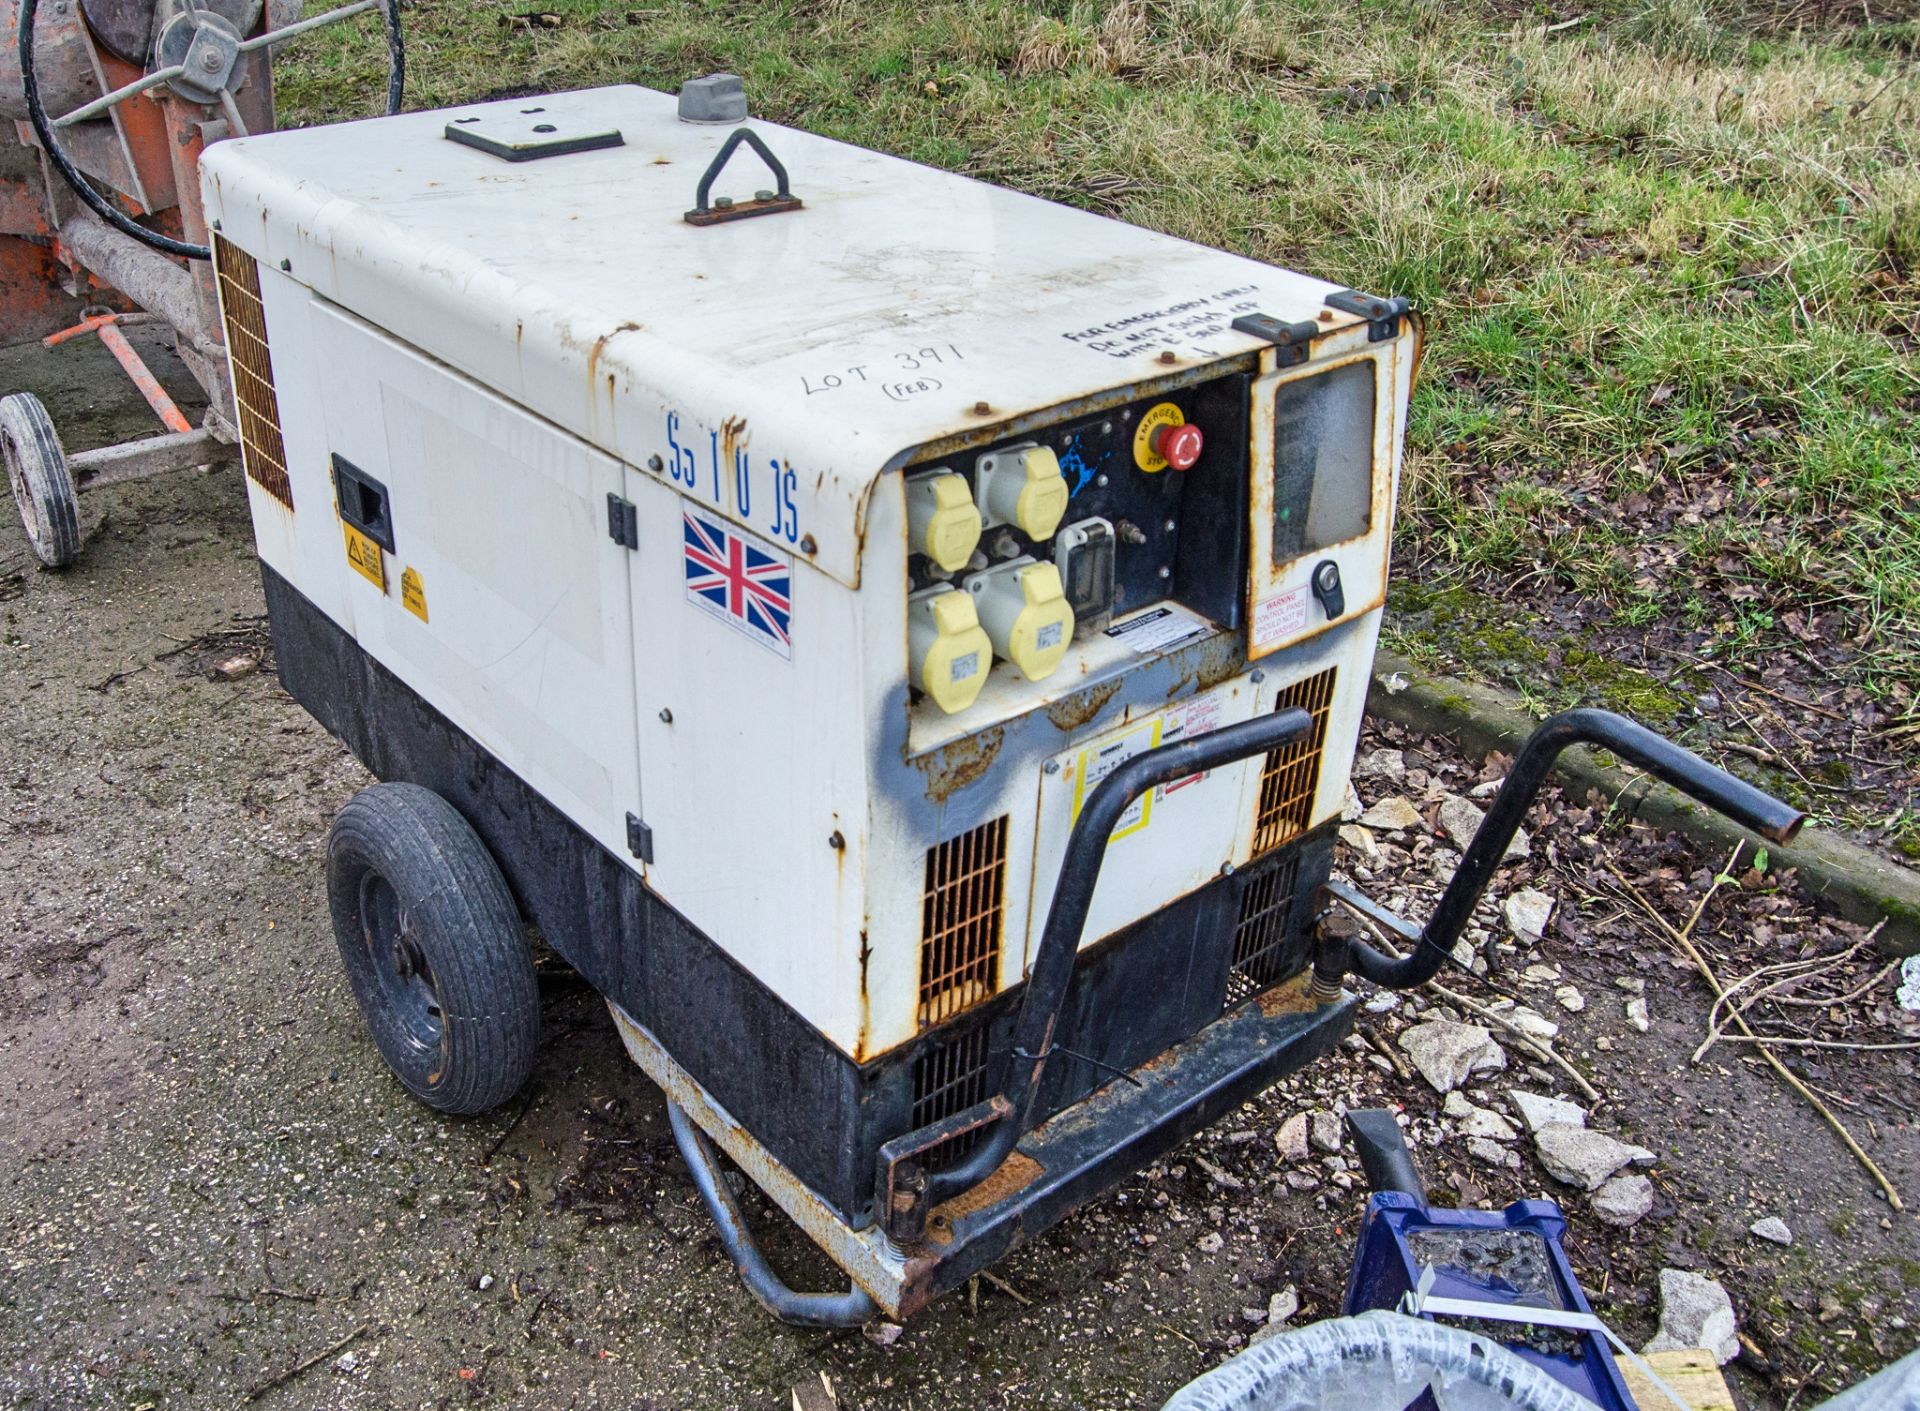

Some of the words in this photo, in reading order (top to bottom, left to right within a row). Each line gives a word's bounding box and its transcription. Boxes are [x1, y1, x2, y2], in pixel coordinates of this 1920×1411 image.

[801, 365, 867, 396] LOT
[894, 344, 964, 370] 391
[882, 376, 942, 402] (FEB)
[1139, 408, 1181, 441] EMERGENC
[1146, 455, 1164, 466] STO
[1266, 593, 1296, 610] WARNING
